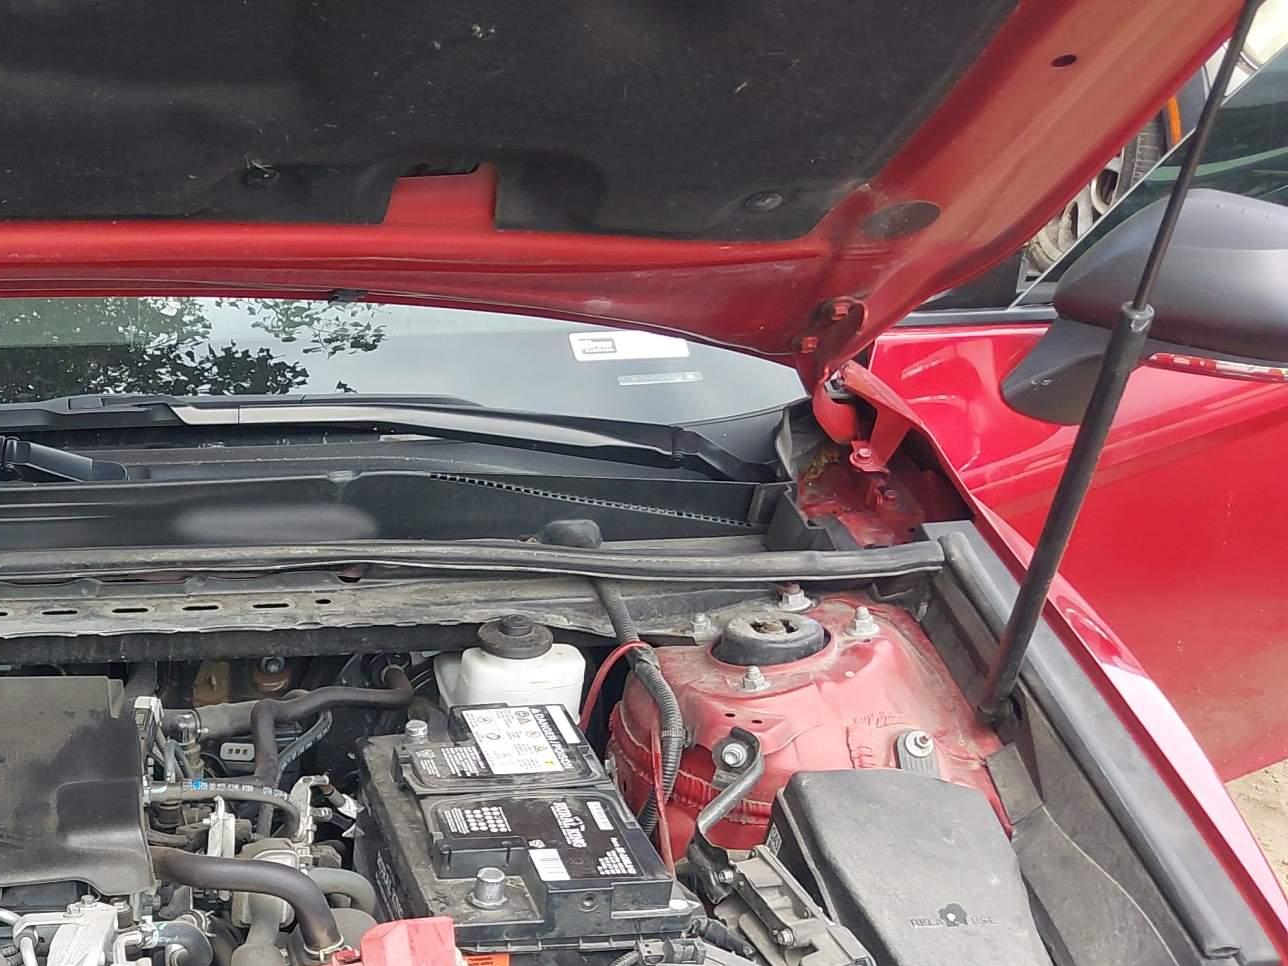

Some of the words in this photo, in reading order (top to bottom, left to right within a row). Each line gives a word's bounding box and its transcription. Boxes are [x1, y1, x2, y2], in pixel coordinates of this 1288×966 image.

[534, 713, 557, 741] DANGER
[551, 743, 574, 769] POISON
[910, 917, 948, 929] RELA
